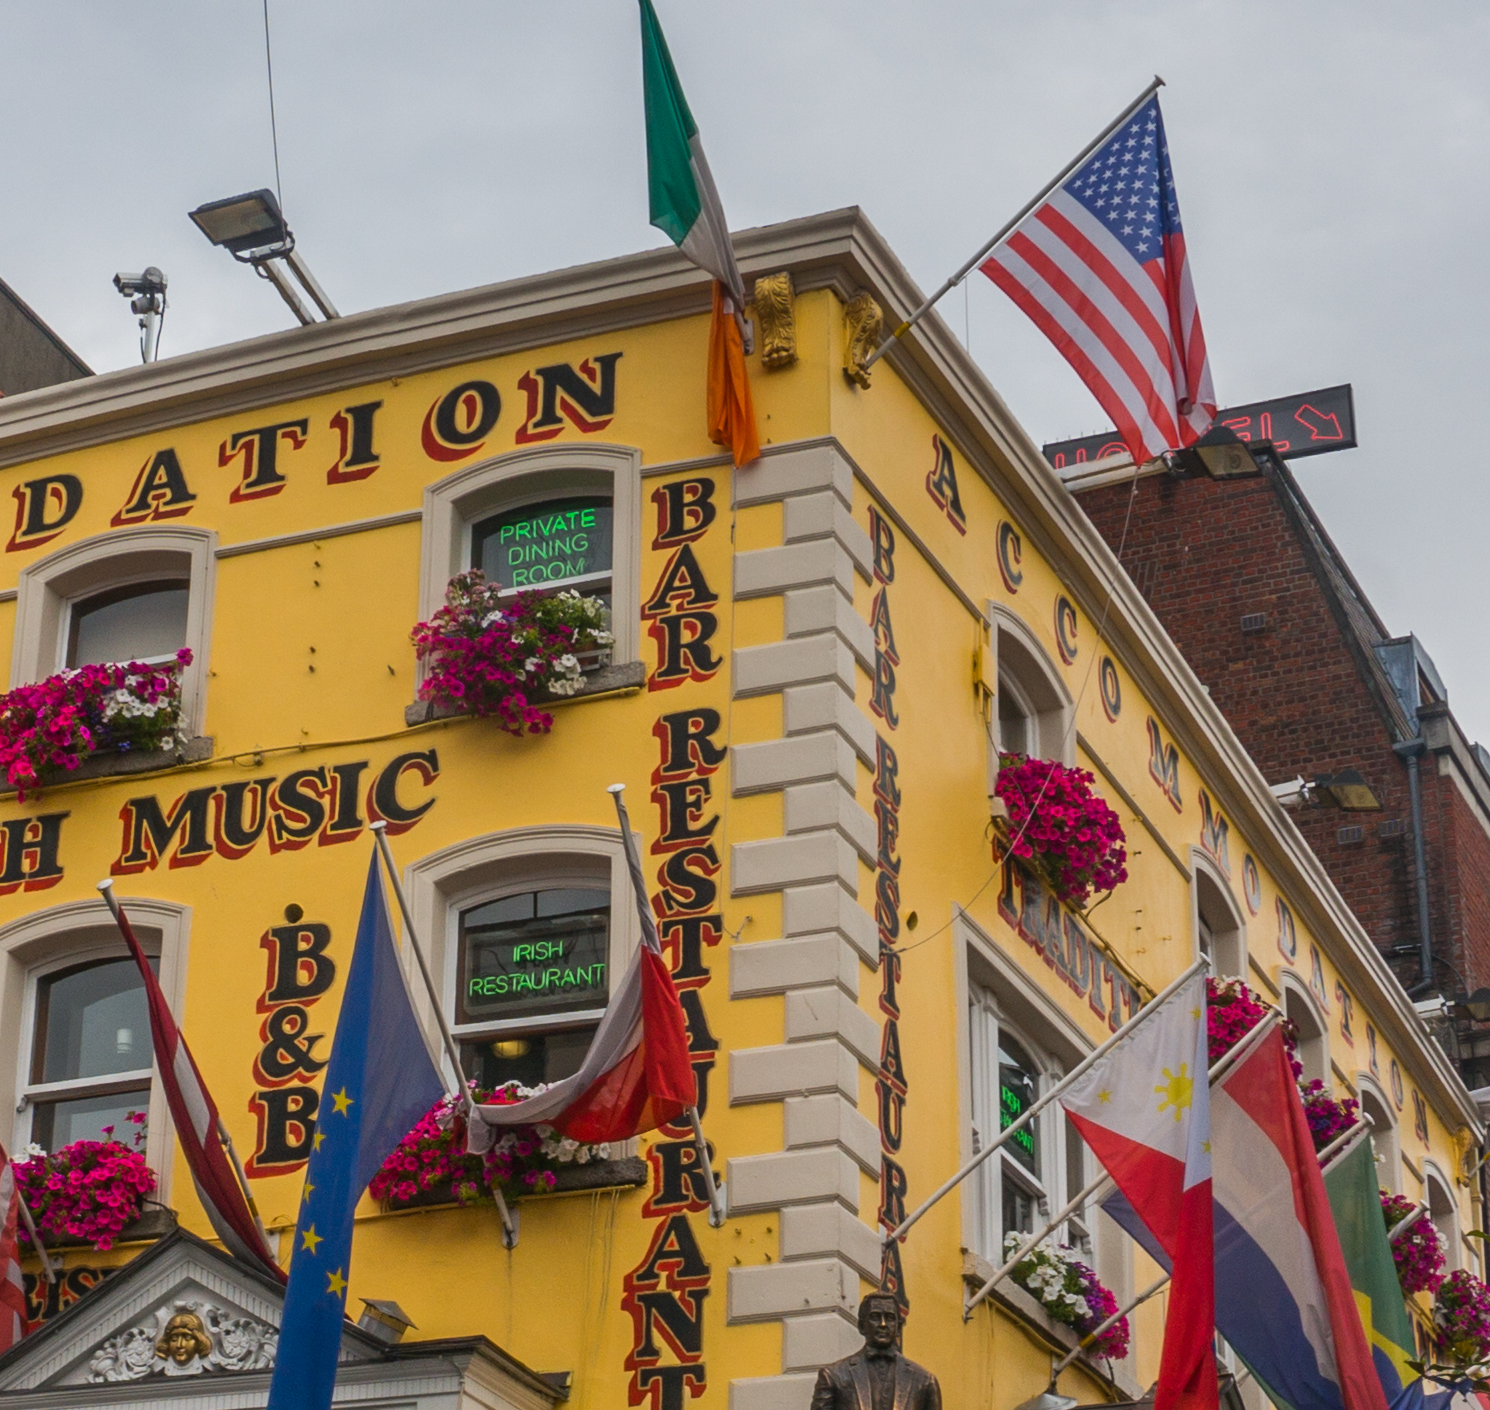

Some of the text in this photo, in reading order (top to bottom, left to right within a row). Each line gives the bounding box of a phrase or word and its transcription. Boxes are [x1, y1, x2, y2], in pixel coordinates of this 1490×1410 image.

[499, 507, 596, 544] PRIVATE
[508, 533, 589, 564] DINING
[512, 559, 587, 585] ROOM
[643, 476, 724, 692] BAR
[111, 747, 443, 876] MUSIC
[925, 433, 1433, 1151] ACCOMMODATION
[512, 940, 565, 963] IRISH
[868, 504, 909, 1318] BAR RESTAURA
[993, 830, 1147, 1033] TRADIT
[467, 963, 606, 998] RESTAURANT
[246, 921, 336, 1180] B&B
